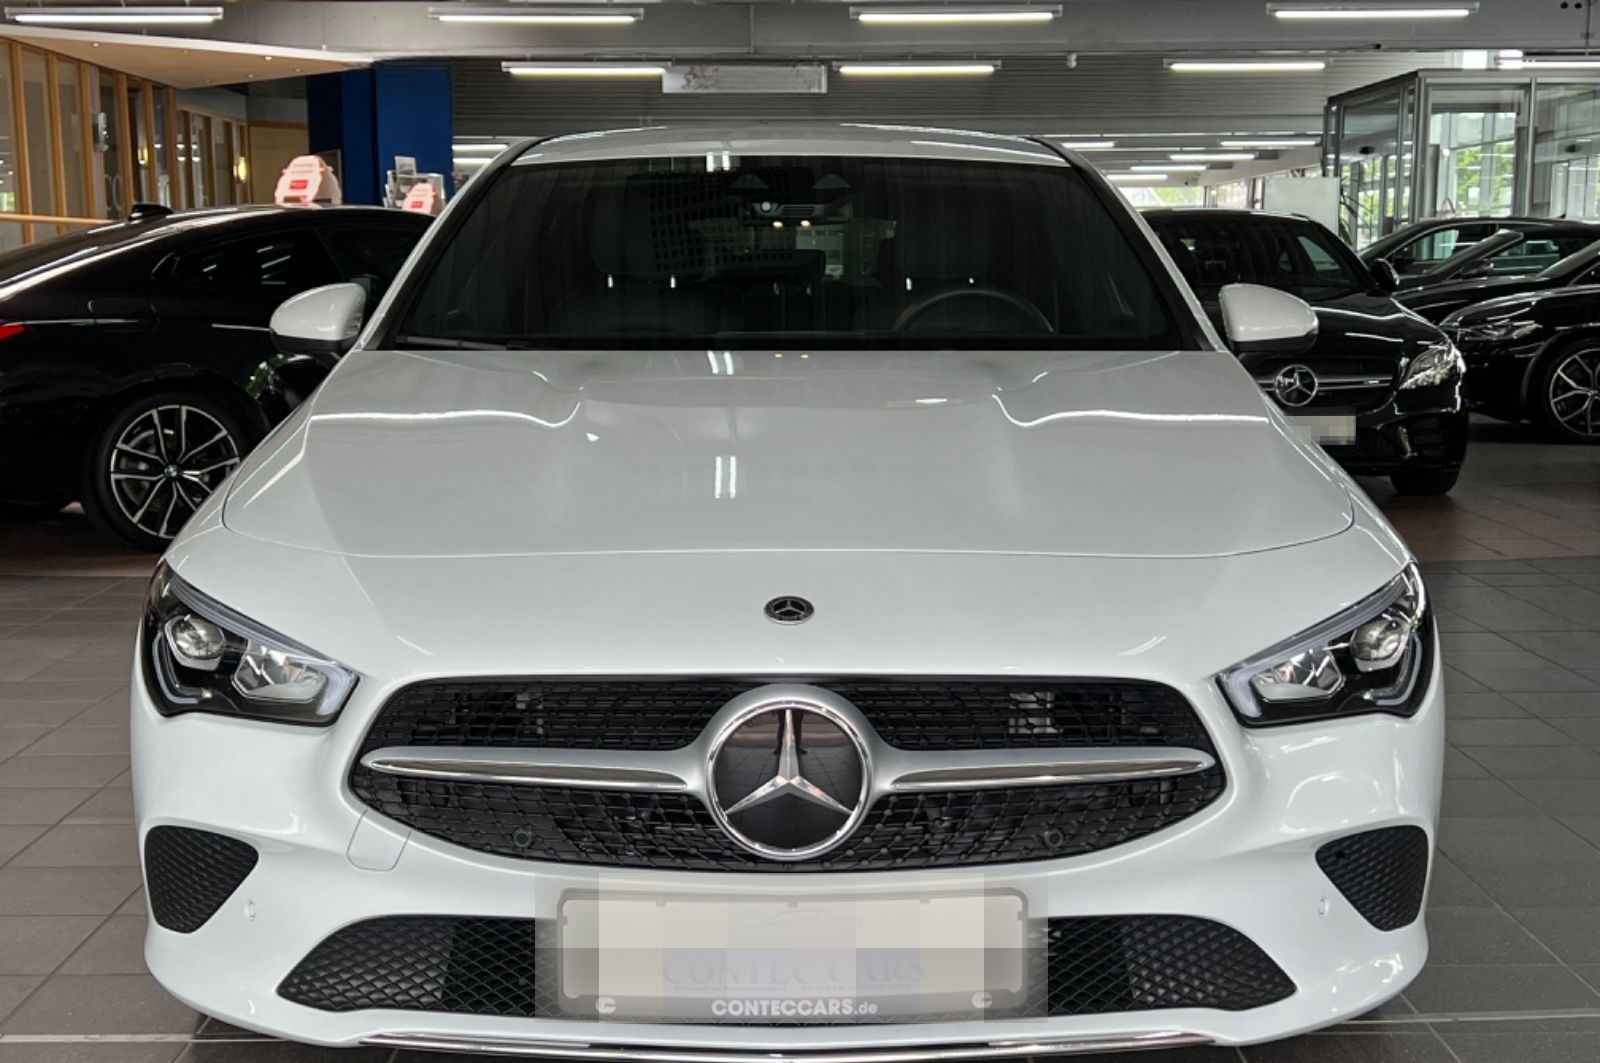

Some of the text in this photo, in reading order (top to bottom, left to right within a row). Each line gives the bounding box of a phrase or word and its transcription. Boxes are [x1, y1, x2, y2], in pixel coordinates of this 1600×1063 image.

[663, 957, 924, 984] CONTEC CARS
[711, 999, 878, 1016] CONTECCARS.de
